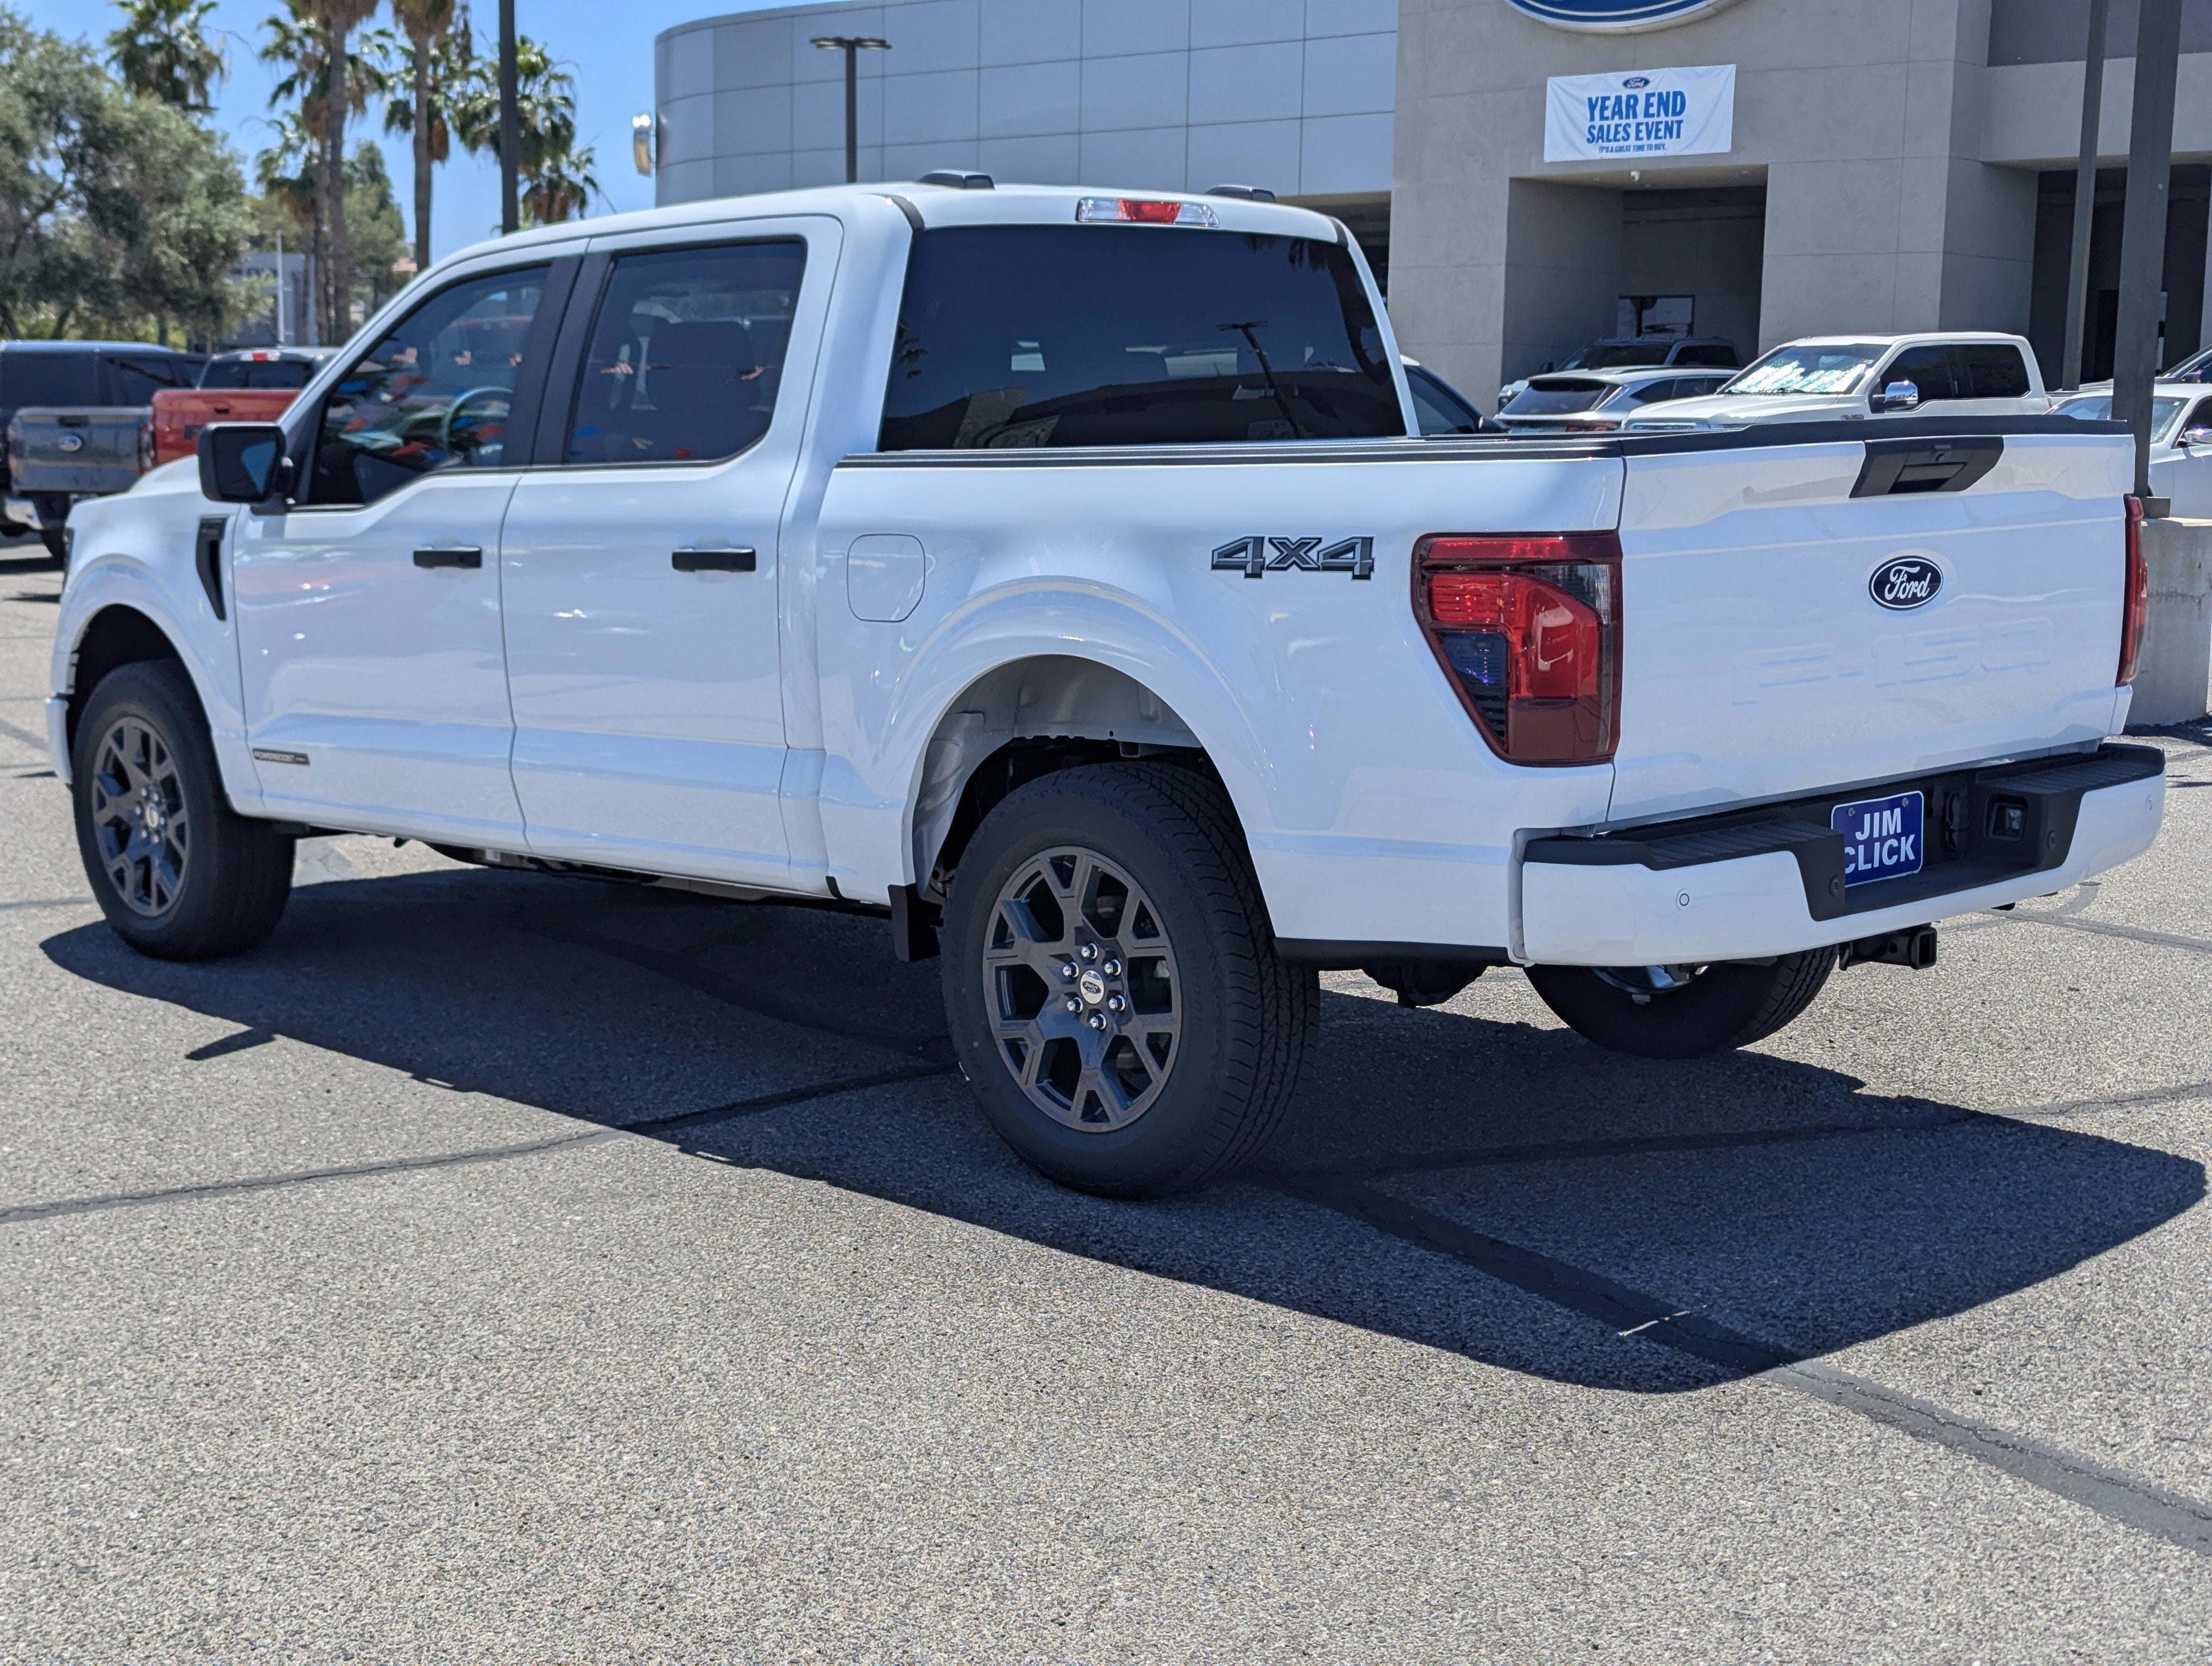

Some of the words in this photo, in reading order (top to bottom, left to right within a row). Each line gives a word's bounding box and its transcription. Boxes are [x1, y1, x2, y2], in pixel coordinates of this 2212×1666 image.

[1587, 94, 1639, 122] YEAR
[1643, 91, 1686, 118] END
[1586, 123, 1631, 144] SALES
[1635, 119, 1684, 142] EVENT
[1599, 145, 1610, 153] IT'S
[1633, 144, 1645, 152] TIME
[1885, 566, 1932, 600] Ford
[1855, 808, 1902, 841] JIM
[1845, 834, 1915, 874] CLICK
